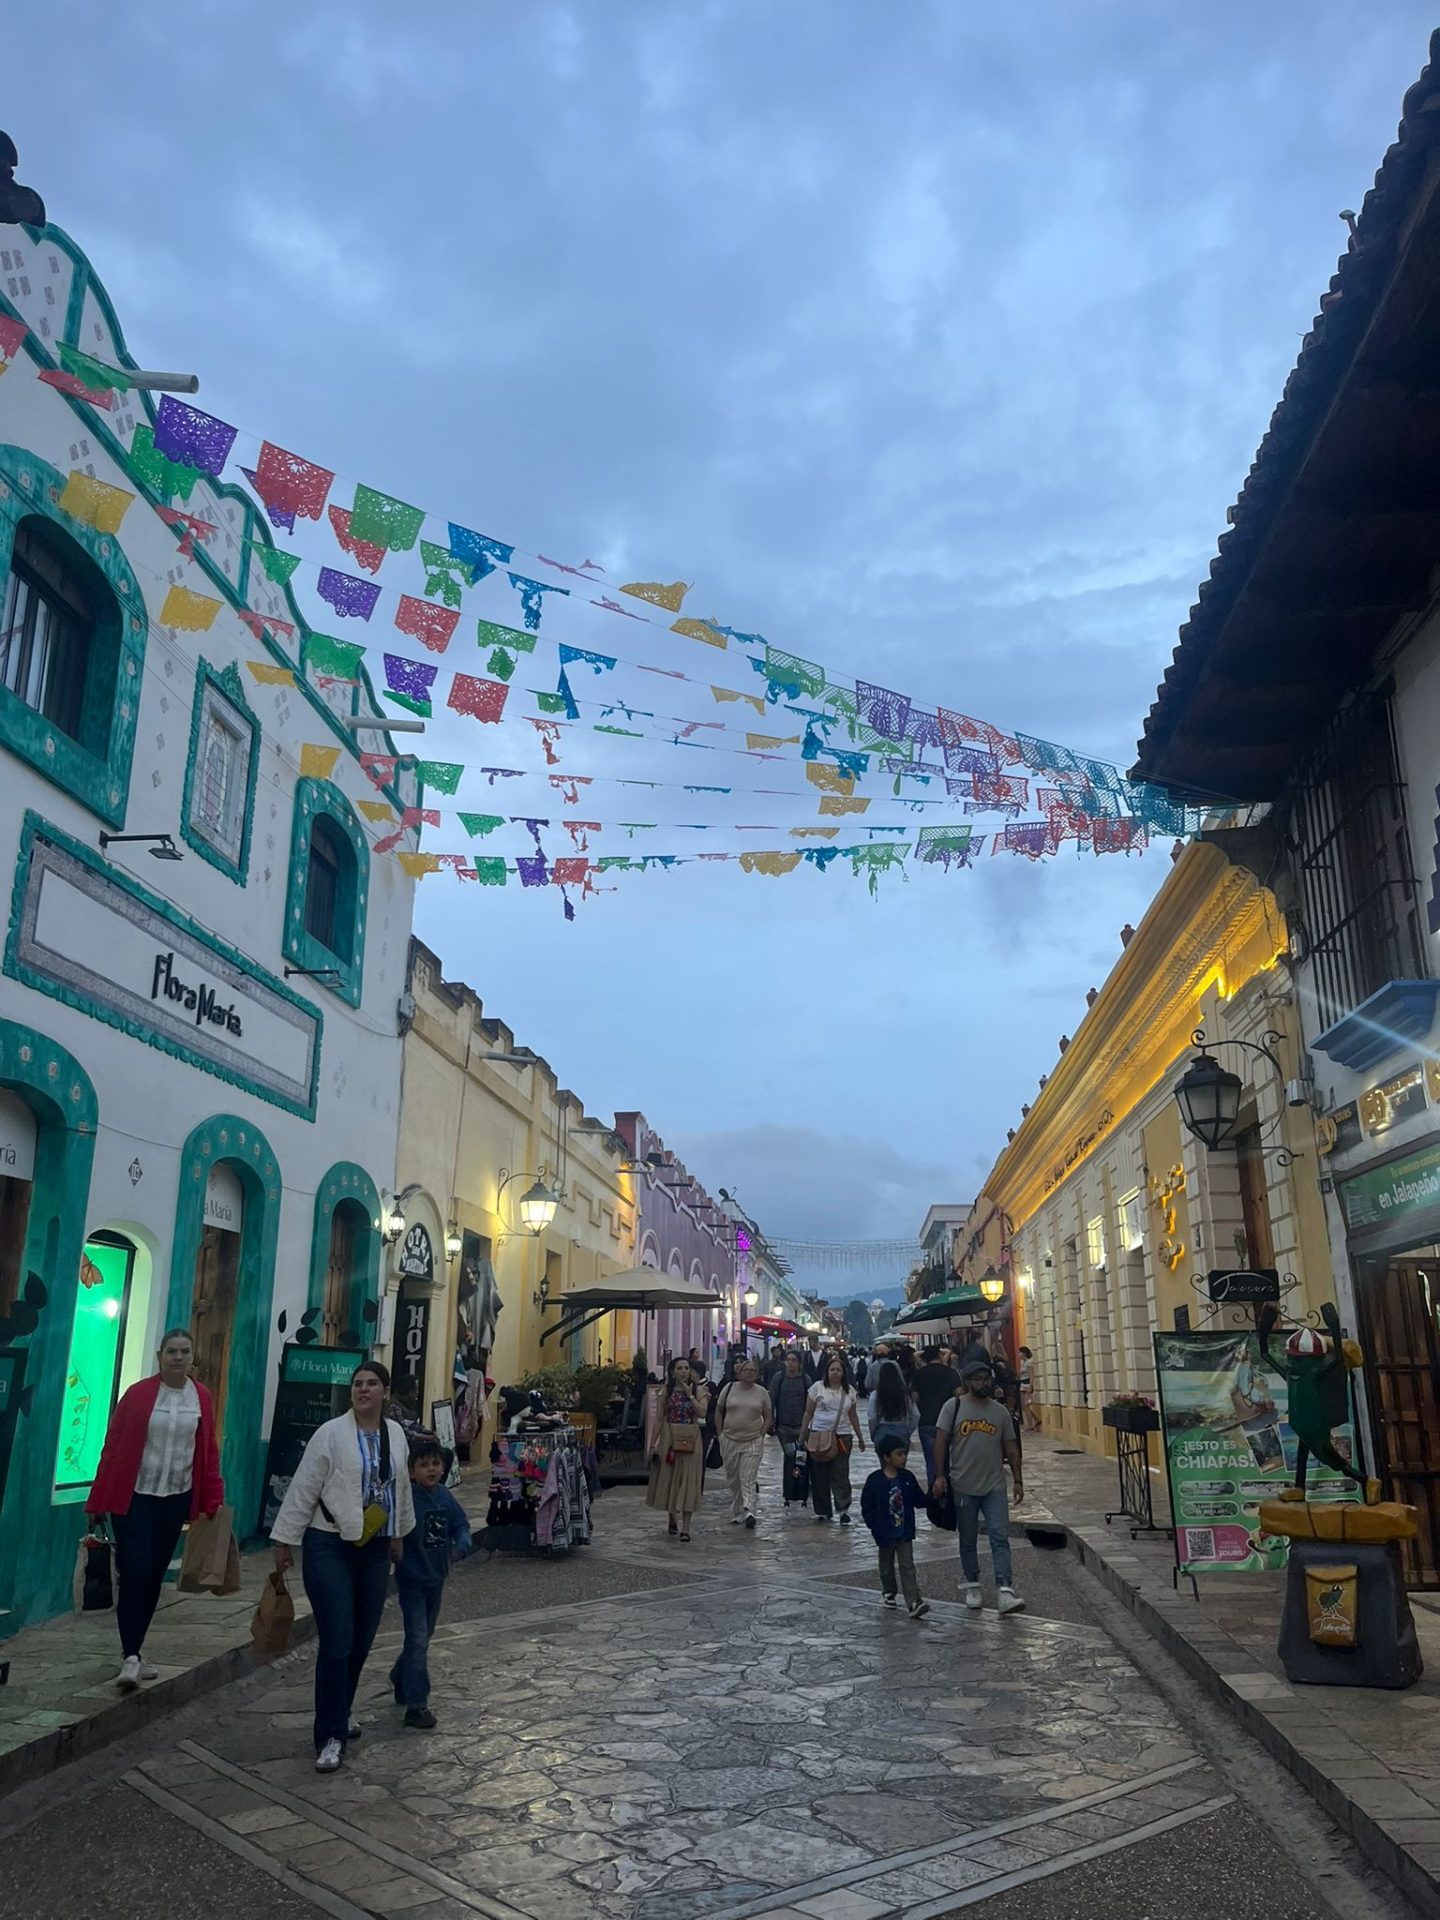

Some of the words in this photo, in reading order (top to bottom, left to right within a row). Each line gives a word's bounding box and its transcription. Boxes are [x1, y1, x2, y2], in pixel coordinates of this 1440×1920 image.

[151, 952, 197, 1010] Flora
[1378, 1191, 1393, 1209] en
[1392, 1171, 1439, 1206] Jalapeño
[302, 1359, 328, 1374] Flora
[329, 1362, 357, 1376] Marí
[1184, 1441, 1220, 1453] ¡ESTO
[1223, 1440, 1237, 1450] ES
[1176, 1453, 1255, 1469] CHIAPAS!
